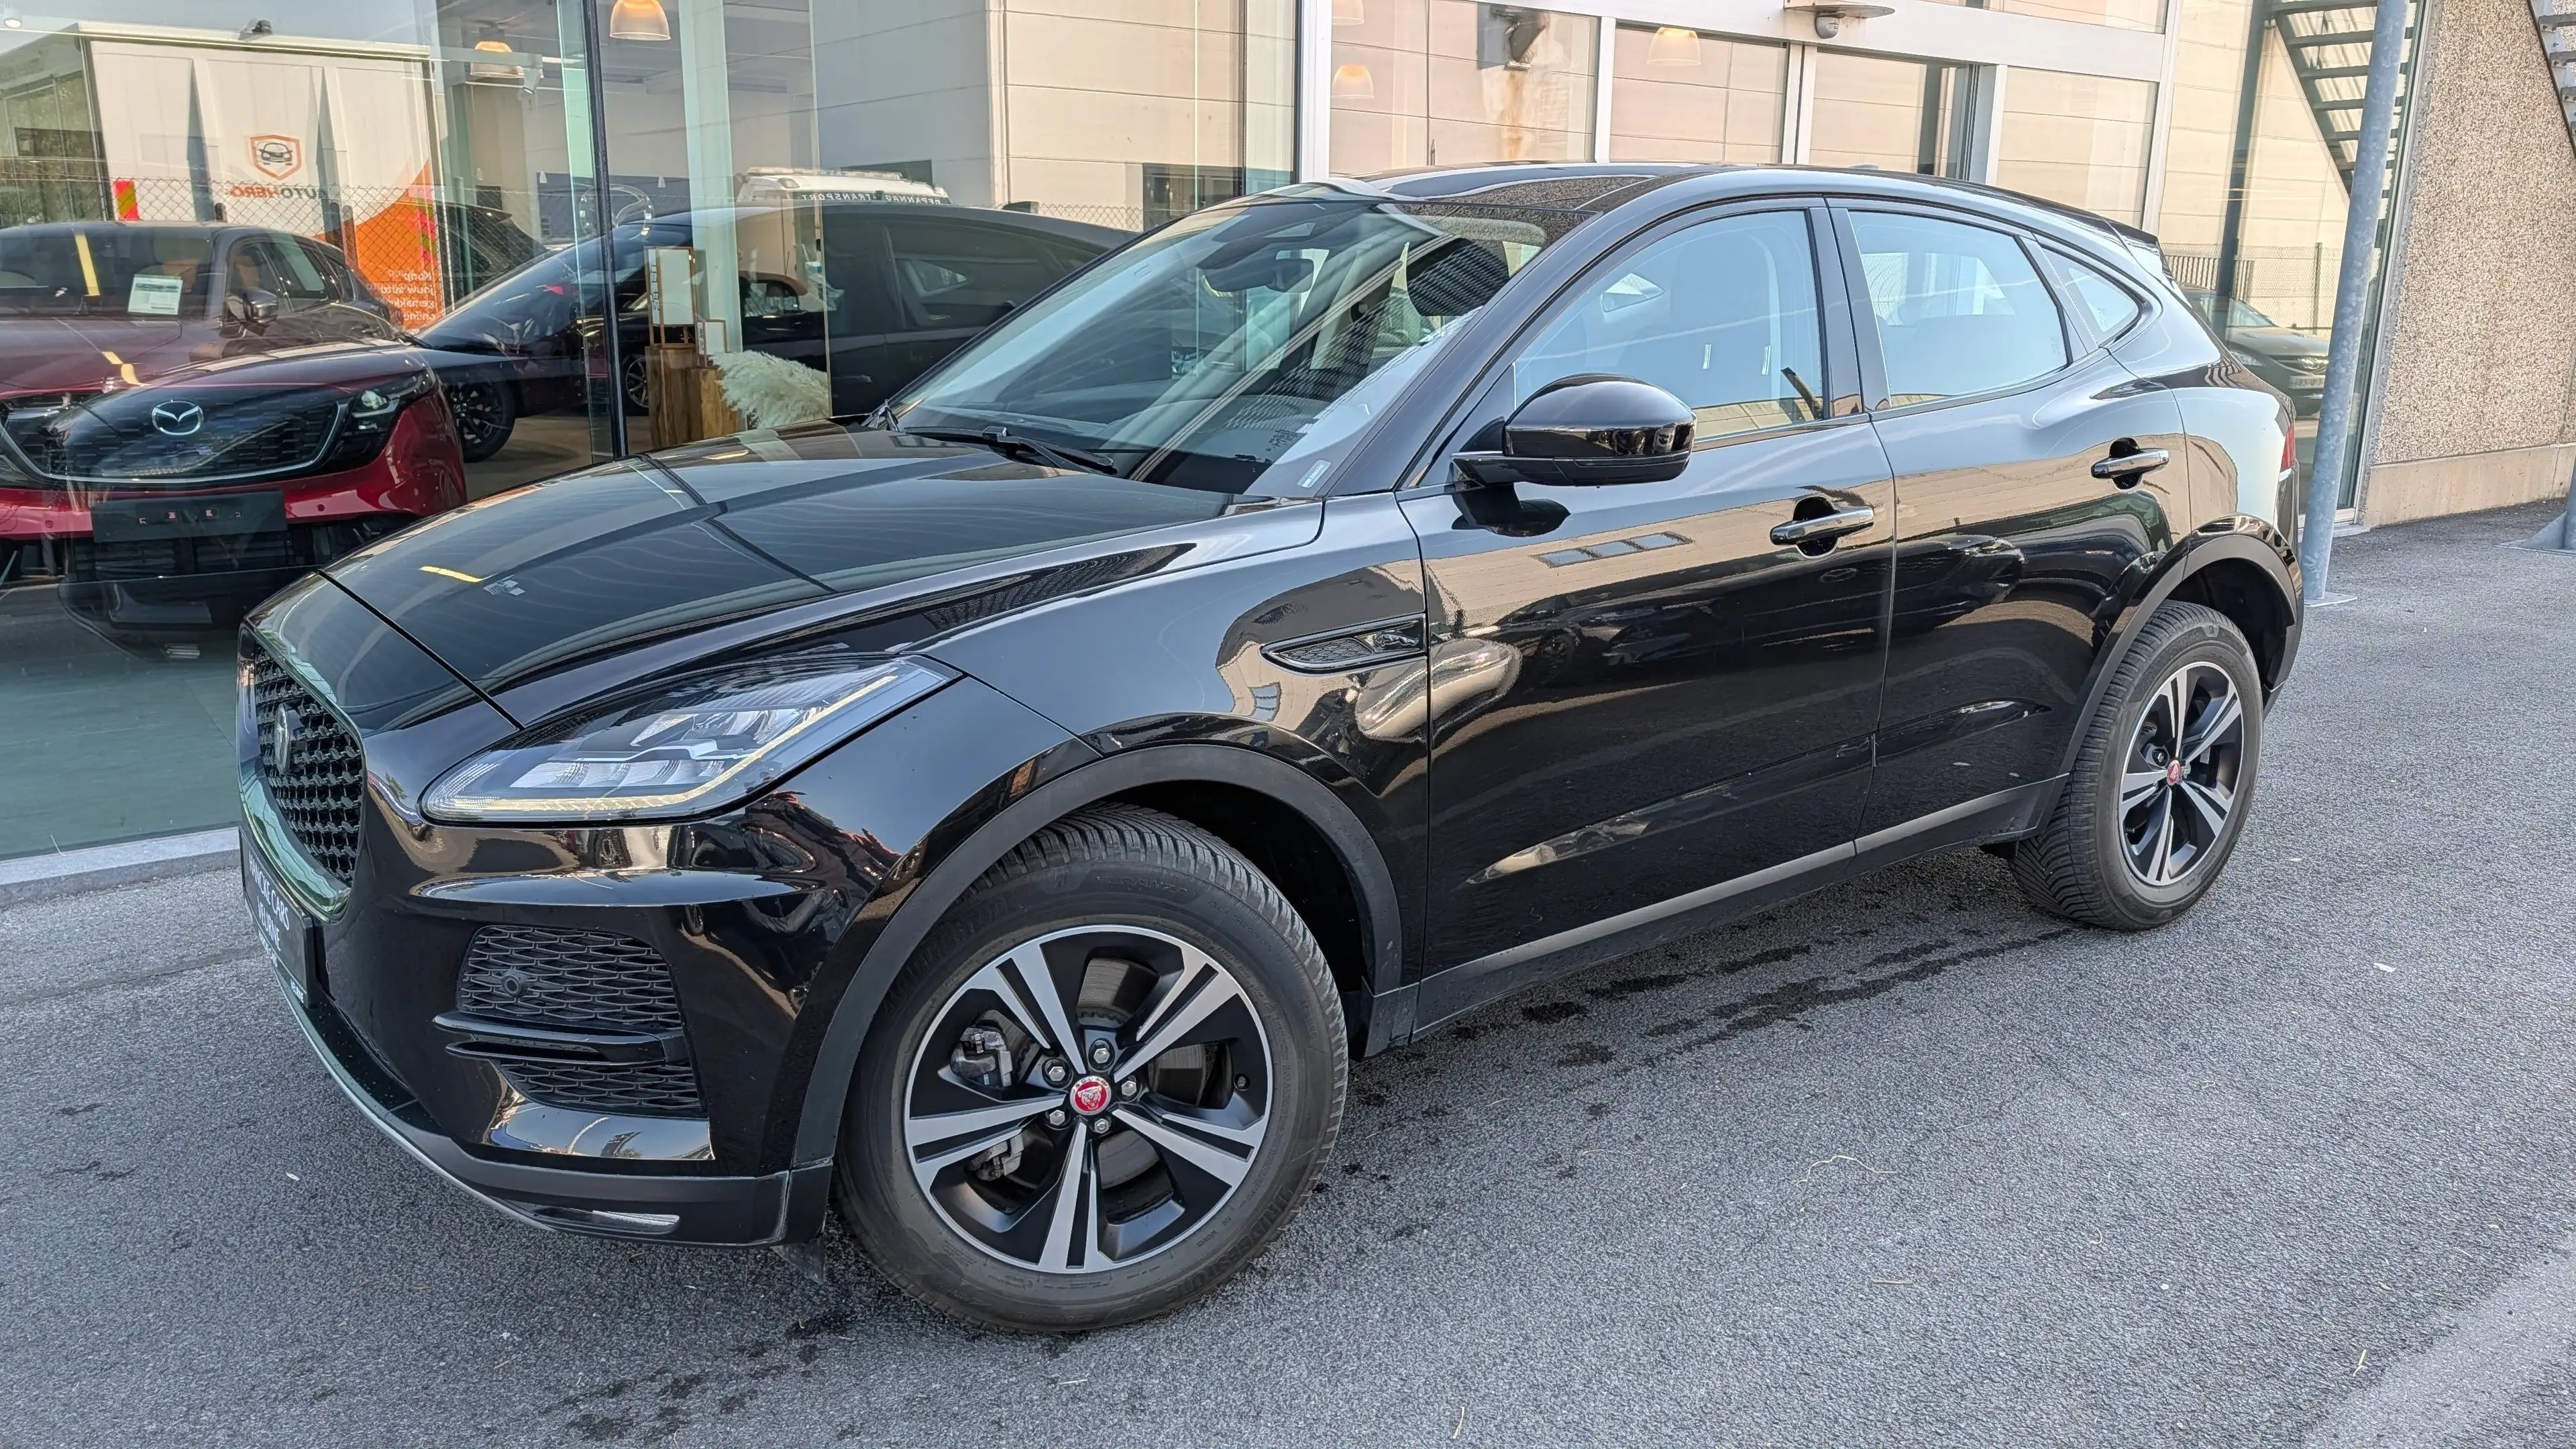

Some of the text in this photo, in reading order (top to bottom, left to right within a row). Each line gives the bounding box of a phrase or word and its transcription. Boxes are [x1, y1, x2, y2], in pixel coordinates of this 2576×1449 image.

[249, 851, 289, 931] HANCKE CARS
[257, 896, 280, 952] VEURNE
